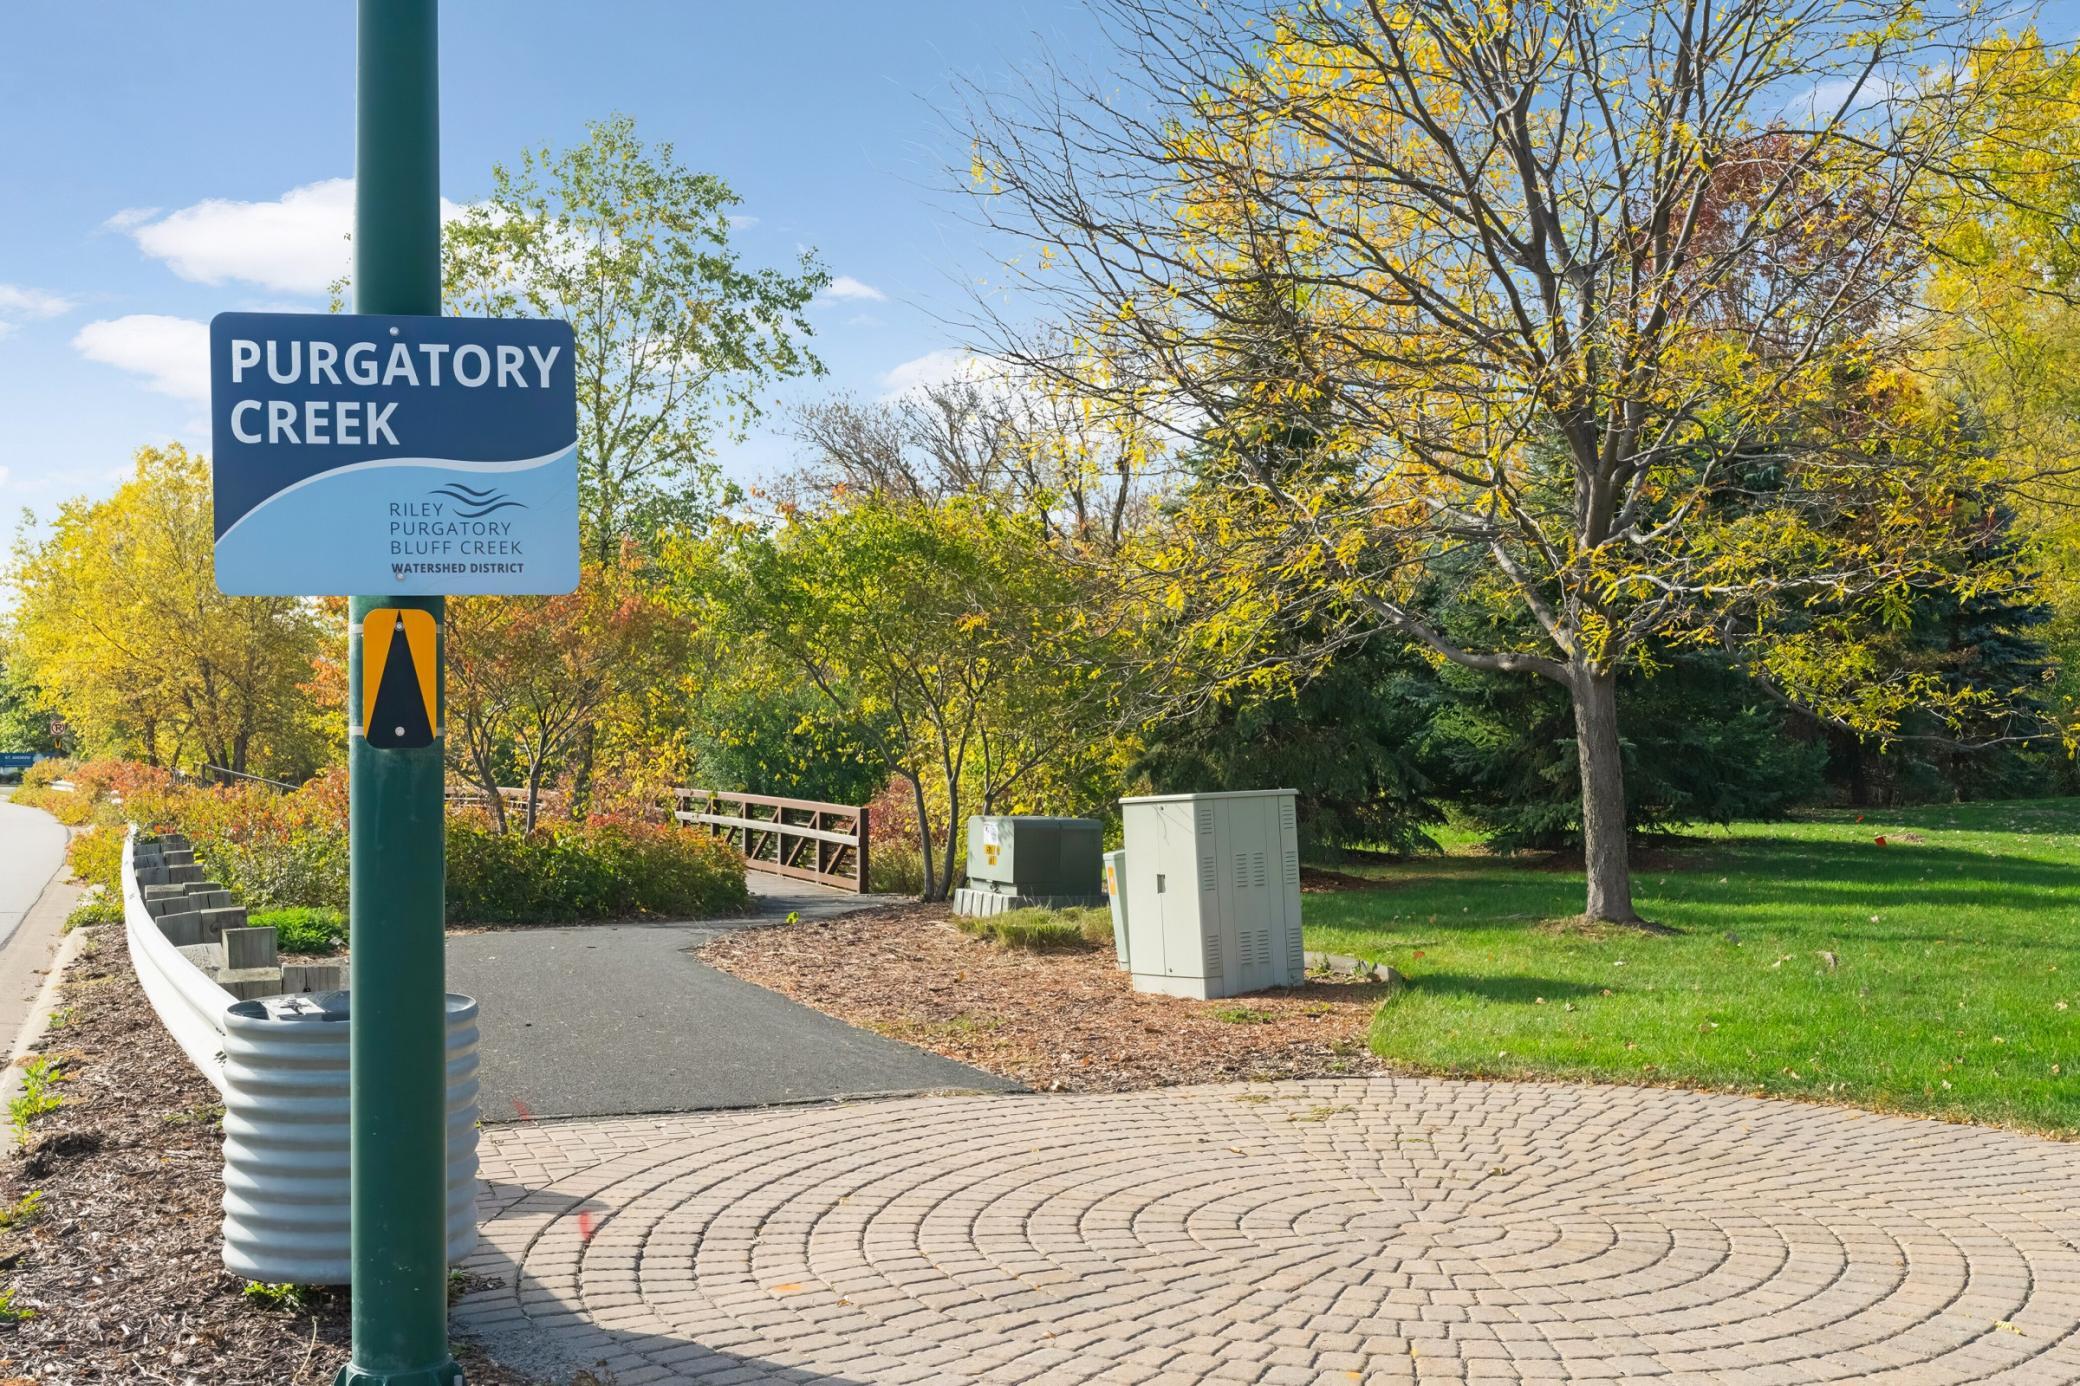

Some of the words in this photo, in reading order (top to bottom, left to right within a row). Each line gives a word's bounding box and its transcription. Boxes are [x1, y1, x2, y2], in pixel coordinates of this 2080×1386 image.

[231, 339, 561, 388] PURGATORY
[230, 399, 400, 445] CREEK
[390, 502, 443, 517] RILEY
[390, 521, 511, 536] PURGATORY
[391, 540, 451, 555] BLUFF
[460, 540, 523, 555] CREEK
[391, 563, 466, 574] WATERSHED
[470, 563, 524, 574] DISTRICT
